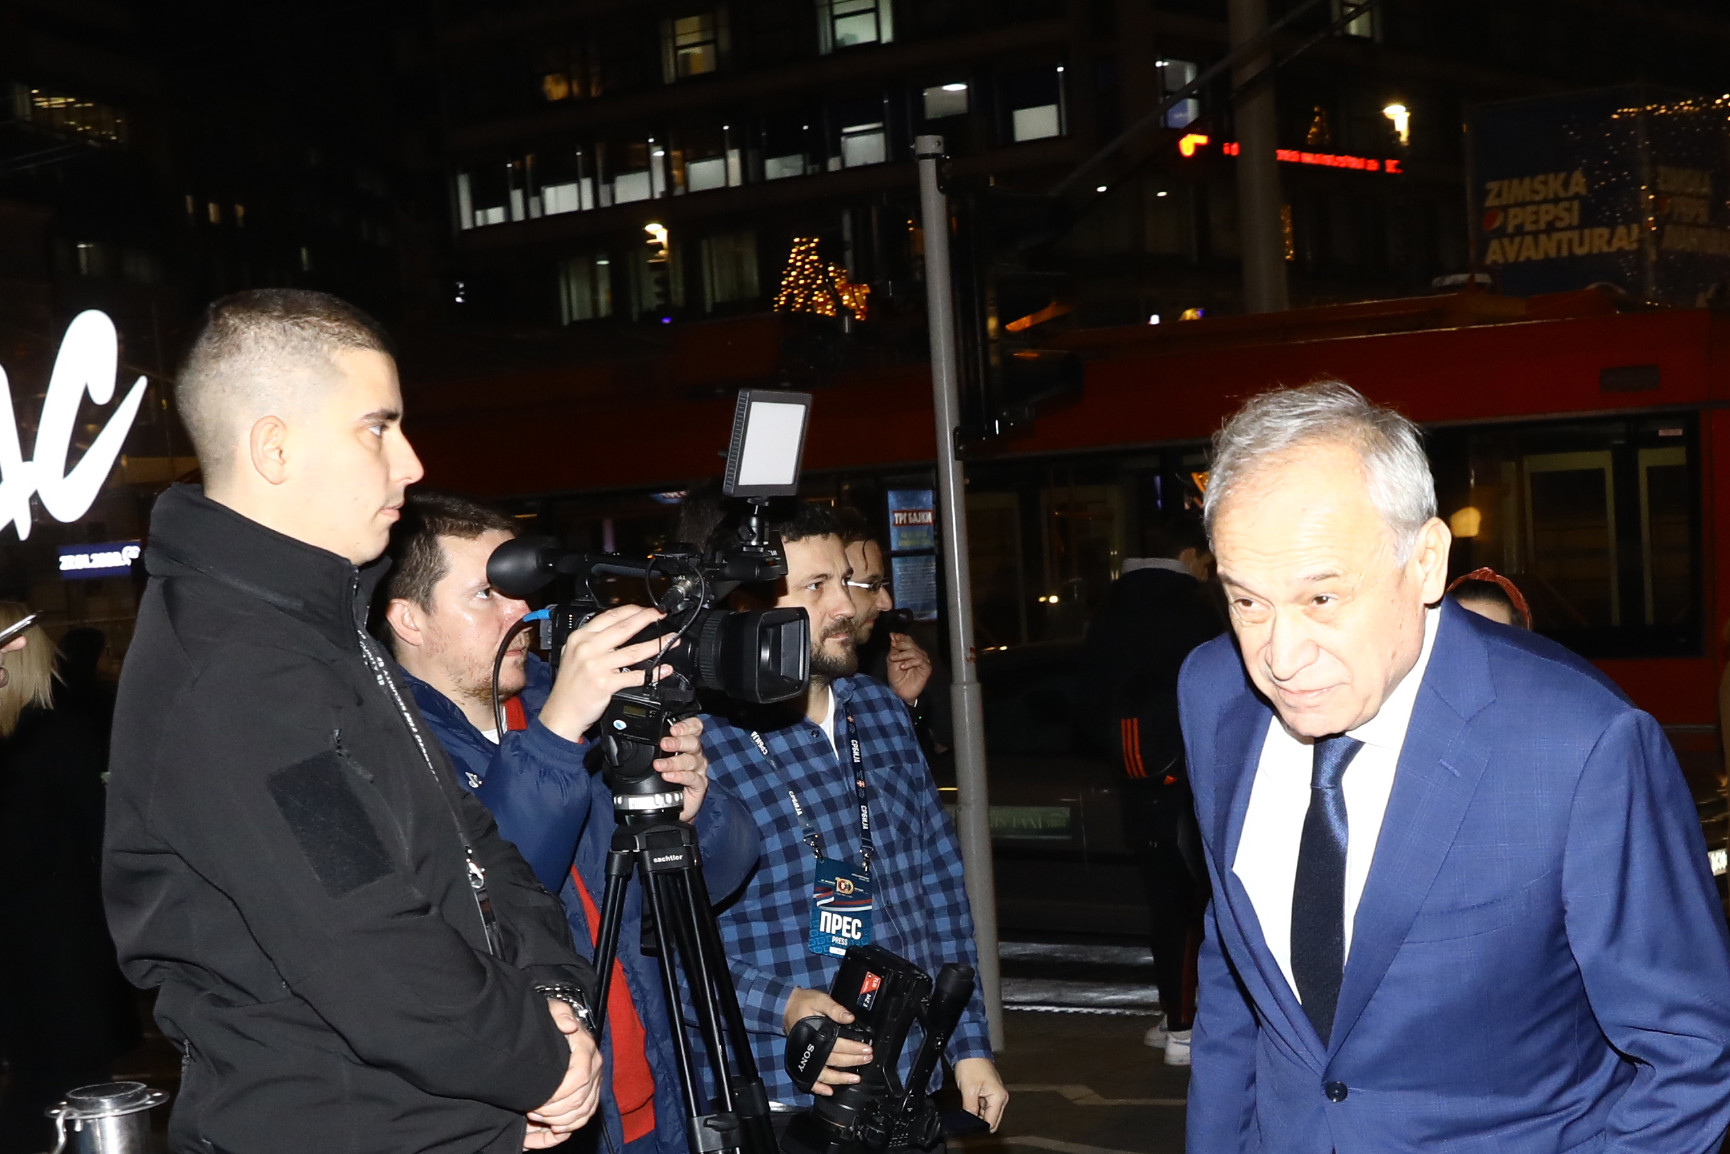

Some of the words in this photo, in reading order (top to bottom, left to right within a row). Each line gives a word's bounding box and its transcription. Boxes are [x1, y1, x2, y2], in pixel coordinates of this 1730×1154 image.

[1484, 170, 1589, 207] ZIMSKA
[1506, 200, 1579, 233] PEPSI
[1484, 223, 1641, 265] AVANTURA!
[653, 854, 683, 863] sachtler
[820, 910, 862, 940] ПРЕС
[831, 935, 848, 946] PRESS
[797, 1043, 816, 1073] SONY
